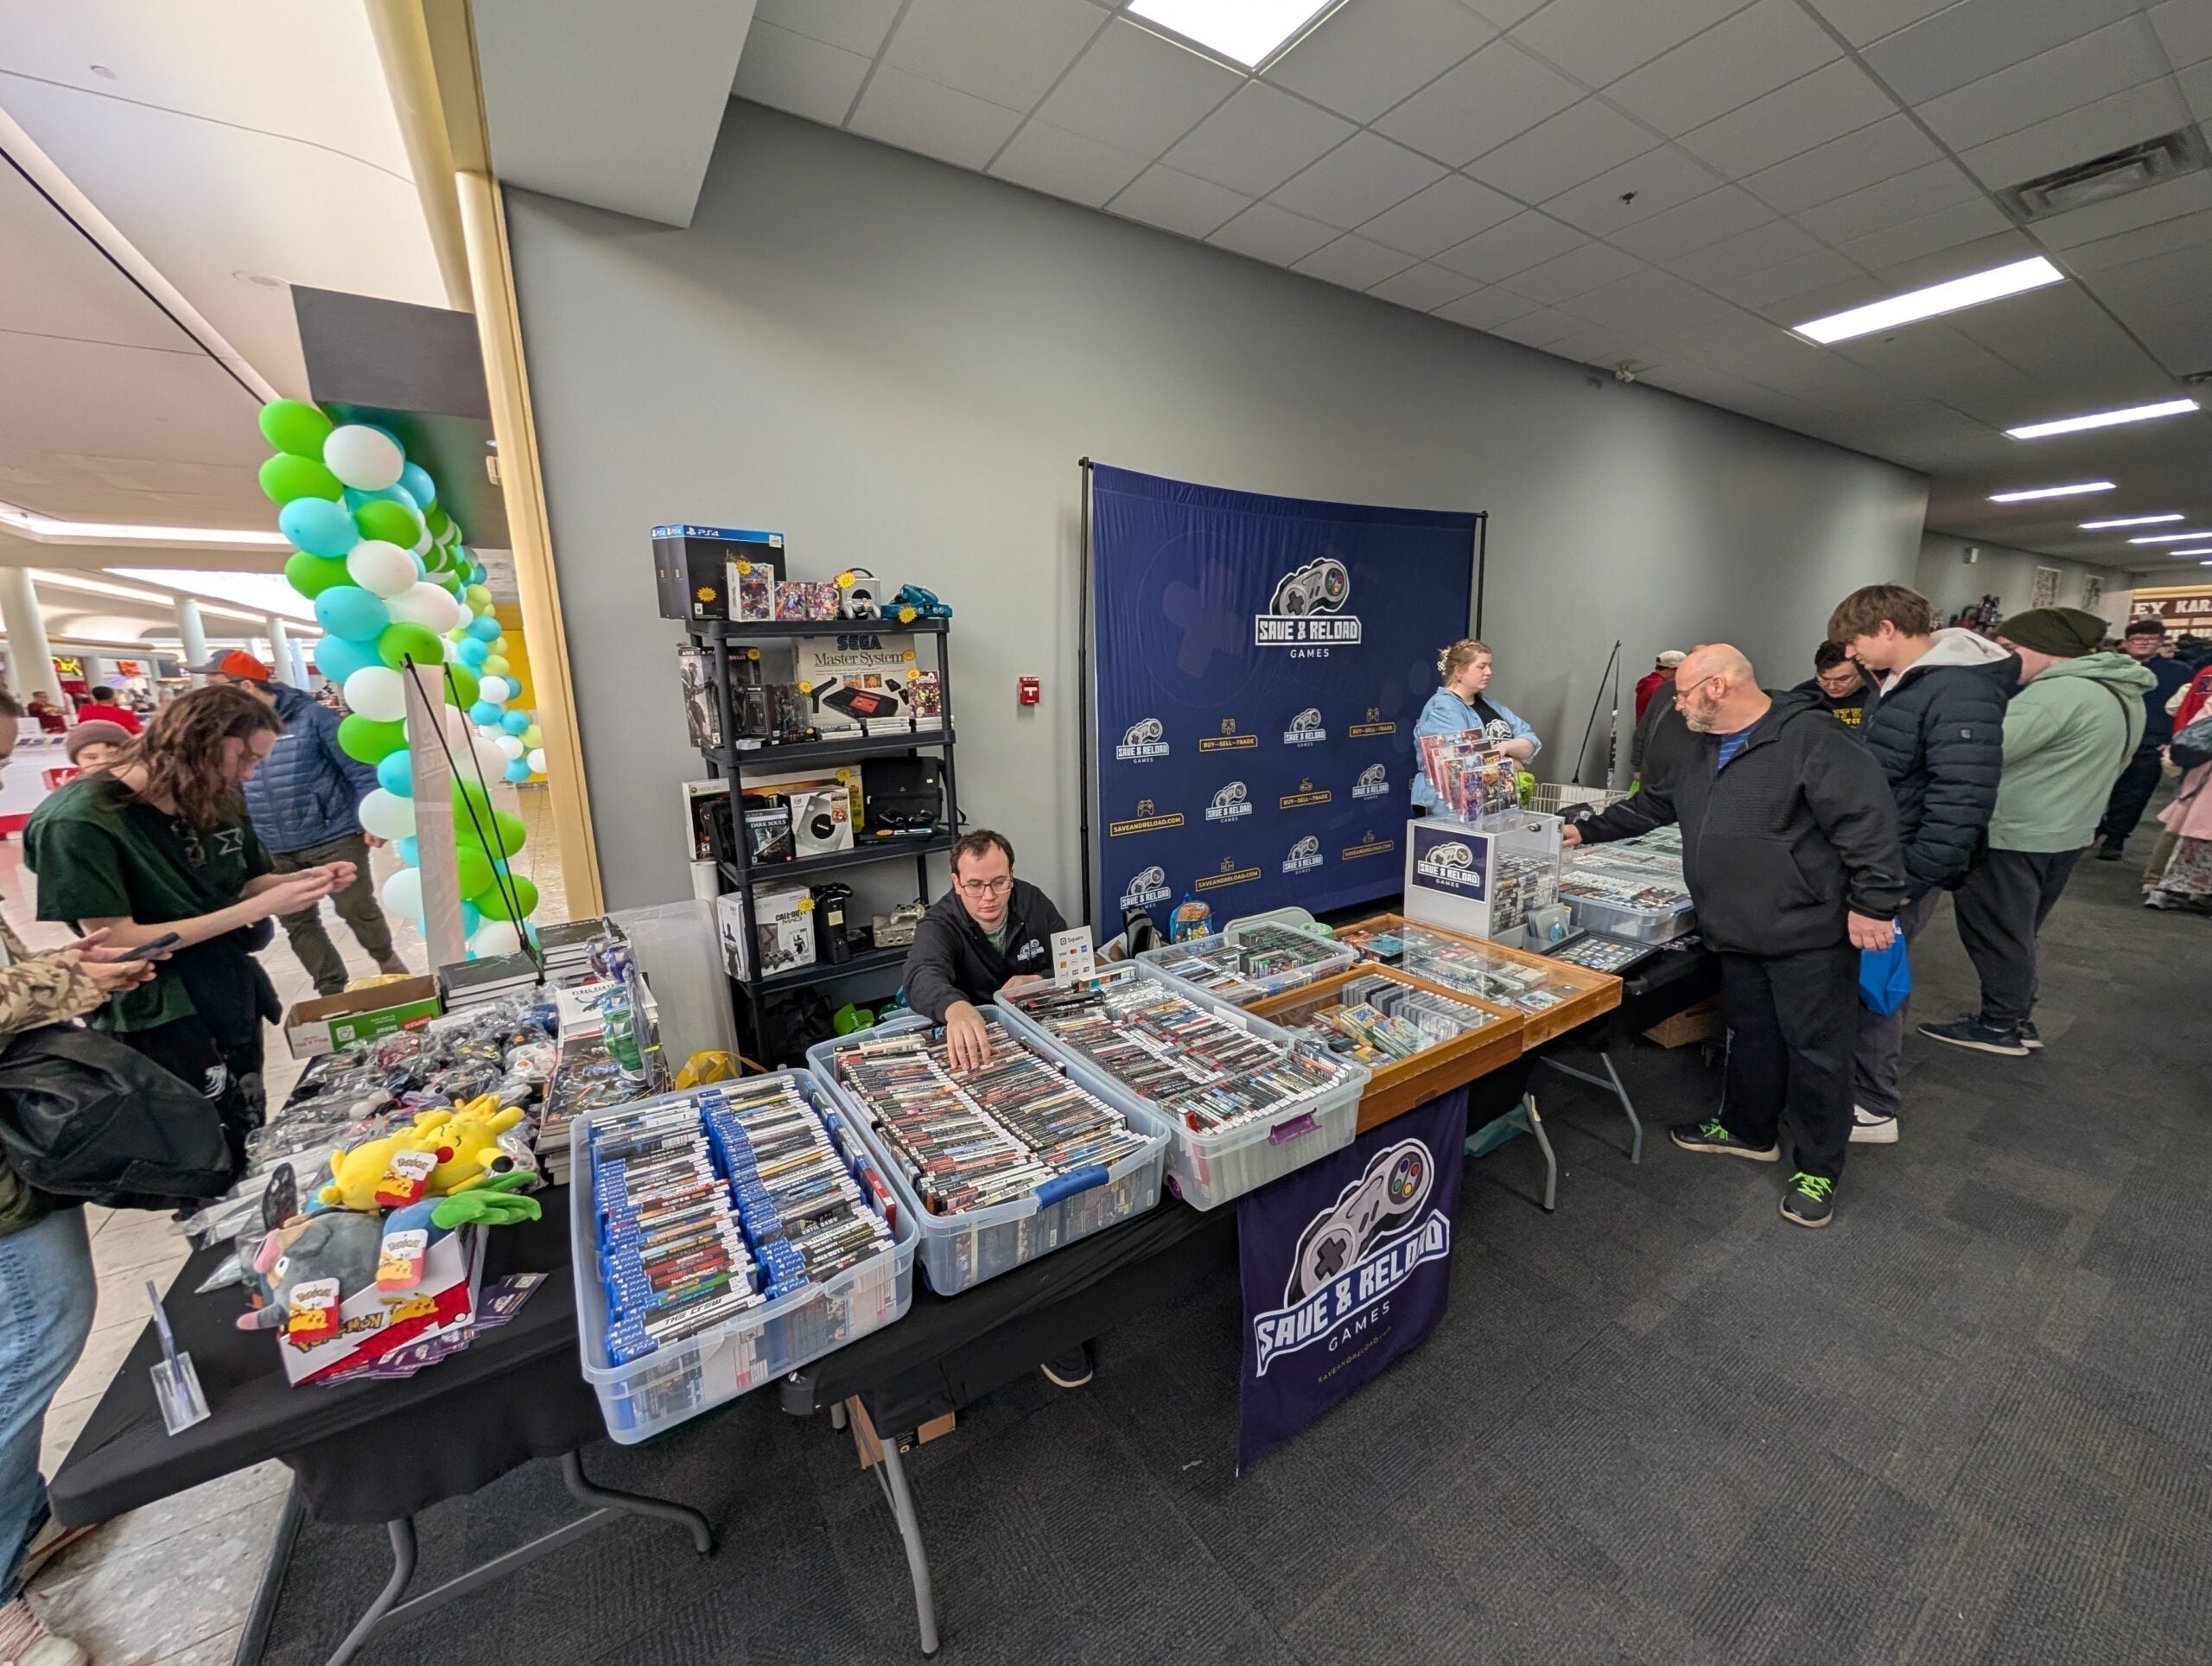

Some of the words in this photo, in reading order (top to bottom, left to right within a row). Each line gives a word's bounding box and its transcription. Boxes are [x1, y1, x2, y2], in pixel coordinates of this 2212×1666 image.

[2175, 600, 2212, 614] KAR
[1260, 621, 1294, 639] SAVE
[1298, 621, 1306, 639] &
[1310, 621, 1358, 639] RELOAD
[836, 635, 882, 651] SEGA
[814, 653, 859, 665] Master
[860, 652, 905, 666] System
[1290, 648, 1329, 658] GAMES
[1286, 733, 1300, 741] SAVE
[1305, 731, 1325, 740] RELOAD
[1118, 747, 1135, 757] SAVE
[1136, 747, 1142, 755] &
[1142, 744, 1167, 755] RELOAD
[1207, 807, 1222, 817] SAVE
[1229, 804, 1251, 814] RELOAD
[1114, 817, 1180, 833] SAVEANDRELOAD.COM
[1198, 871, 1258, 888] SAVEANDRELOAD.COM
[1420, 864, 1438, 875] SAVE
[1440, 868, 1446, 876] &
[1446, 869, 1478, 883] RELOAD
[1436, 879, 1459, 888] GAMES
[1122, 897, 1139, 907] SAVE
[1146, 890, 1169, 902] RELOAD
[1068, 935, 1084, 944] Square
[802, 1225, 819, 1235] UNTIL
[812, 1254, 829, 1263] CALL
[830, 1247, 844, 1256] DUTY
[1257, 1292, 1329, 1362] SAVE
[1336, 1277, 1351, 1317] &
[1359, 1218, 1443, 1300] RELOAD
[664, 1312, 686, 1326] THE
[691, 1298, 722, 1314] CREW
[1329, 1301, 1390, 1351] GAMES
